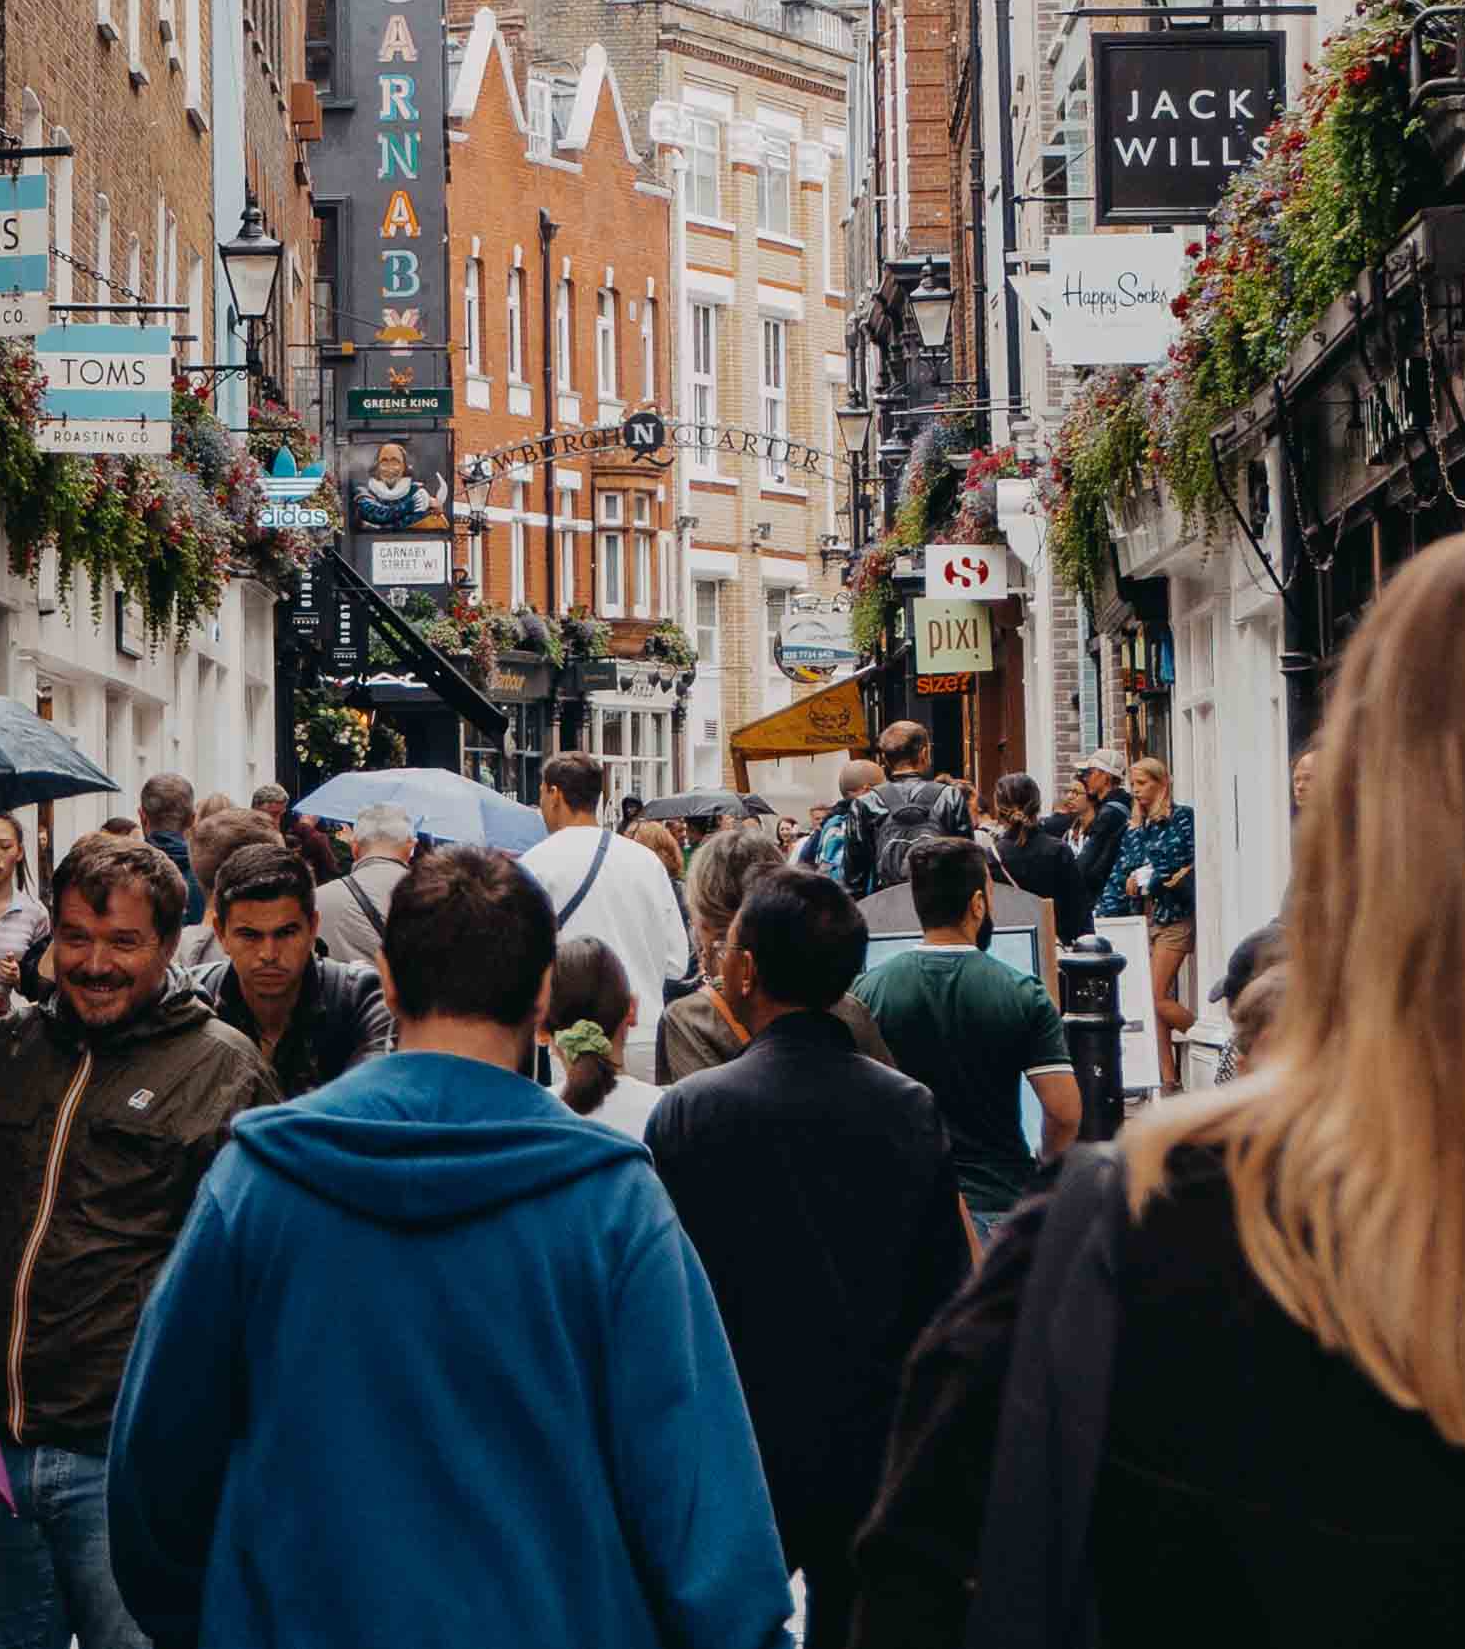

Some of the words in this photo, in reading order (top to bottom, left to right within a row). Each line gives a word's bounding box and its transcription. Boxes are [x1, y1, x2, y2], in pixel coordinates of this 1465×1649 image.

[1127, 89, 1255, 122] JACK
[1114, 136, 1271, 167] WILLS
[1062, 271, 1118, 315] Happy
[1117, 271, 1168, 308] Socks
[3, 309, 28, 325] CO.
[60, 358, 146, 385] TOMS
[363, 398, 406, 409] GREENE
[410, 398, 439, 408] KING
[54, 430, 125, 443] ROASTING
[479, 424, 622, 475] WBURGH
[673, 426, 819, 472] QUARTER
[261, 505, 327, 527] adidas
[380, 546, 427, 558] CARNABY
[382, 559, 416, 569] STREET
[918, 671, 971, 694] size?
